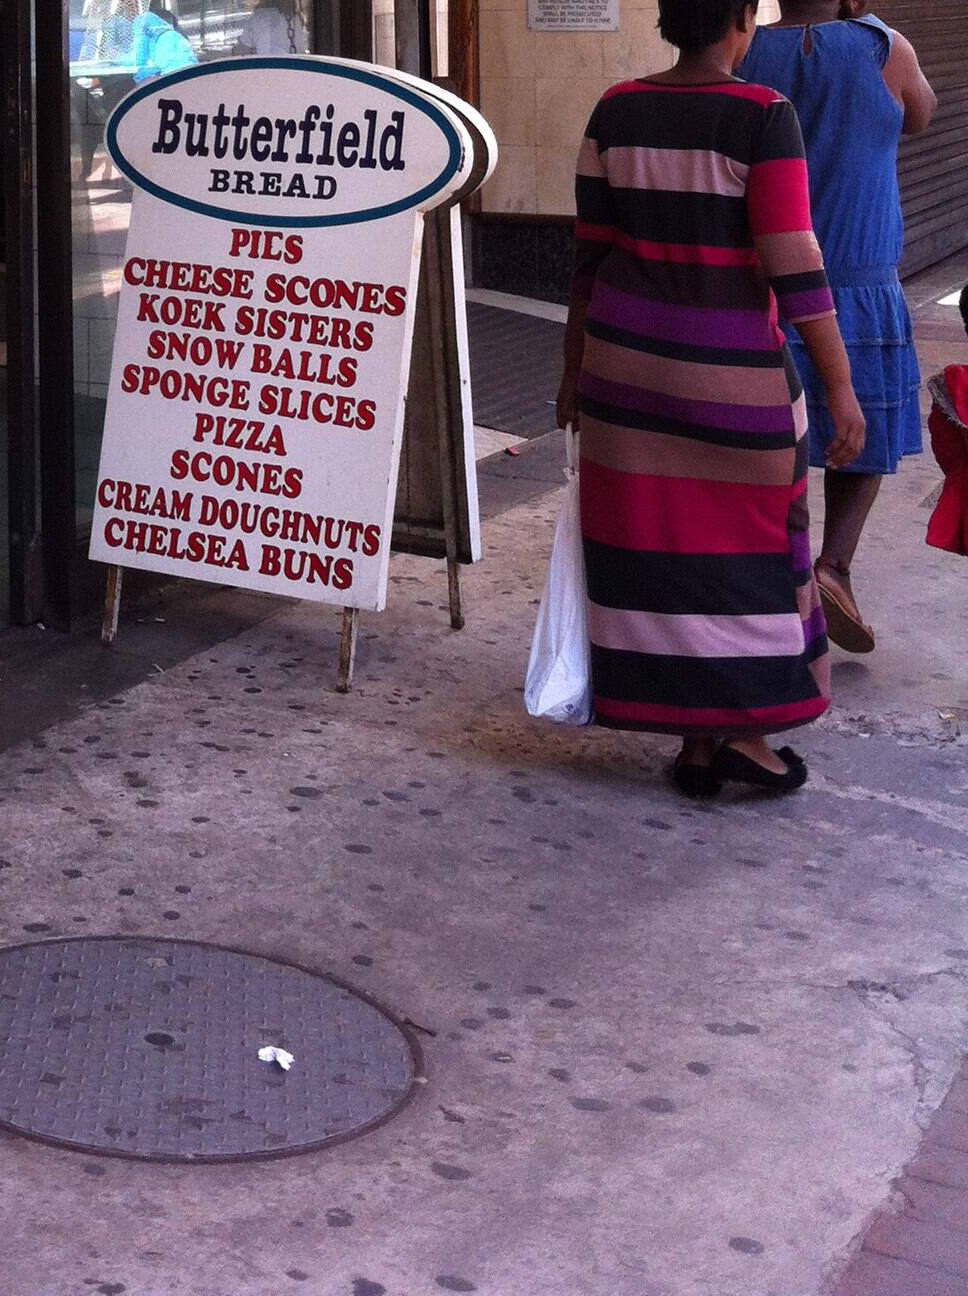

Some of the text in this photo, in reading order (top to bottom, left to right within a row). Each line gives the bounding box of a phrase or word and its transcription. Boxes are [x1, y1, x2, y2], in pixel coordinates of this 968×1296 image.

[152, 98, 406, 171] Butterfield
[208, 168, 338, 201] BREAD
[229, 227, 305, 265] PIES
[123, 256, 407, 318] CHEESE SCONES
[136, 292, 375, 353] KOEK SISTERS
[147, 330, 358, 389] SNOW BALLS
[121, 363, 378, 432] SPONGE SLICES
[192, 413, 288, 459] PIZZA
[170, 449, 304, 500] SCONES
[97, 478, 381, 558] CREAM DOUGHNUTS
[103, 516, 354, 591] CHELSEA BUNS
